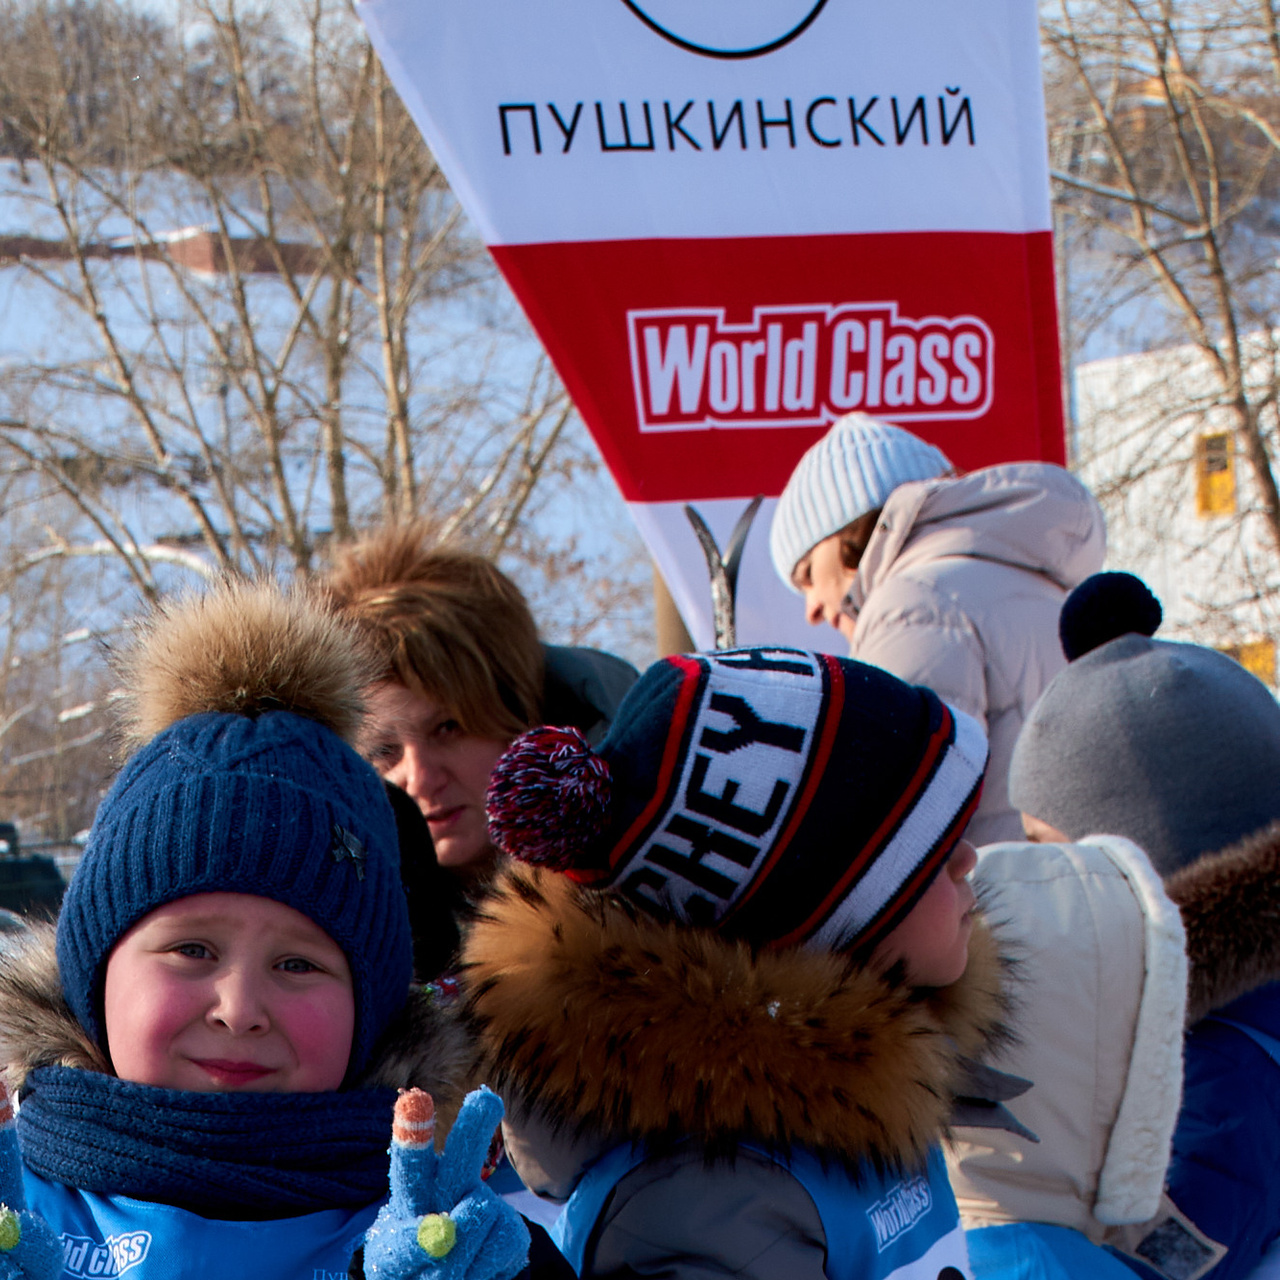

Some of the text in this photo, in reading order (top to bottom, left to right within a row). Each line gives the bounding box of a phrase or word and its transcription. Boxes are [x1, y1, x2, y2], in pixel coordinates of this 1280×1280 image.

[498, 87, 976, 156] ПУШКИНСКИЙ
[643, 317, 983, 416] World Class
[87, 1234, 147, 1276] Class
